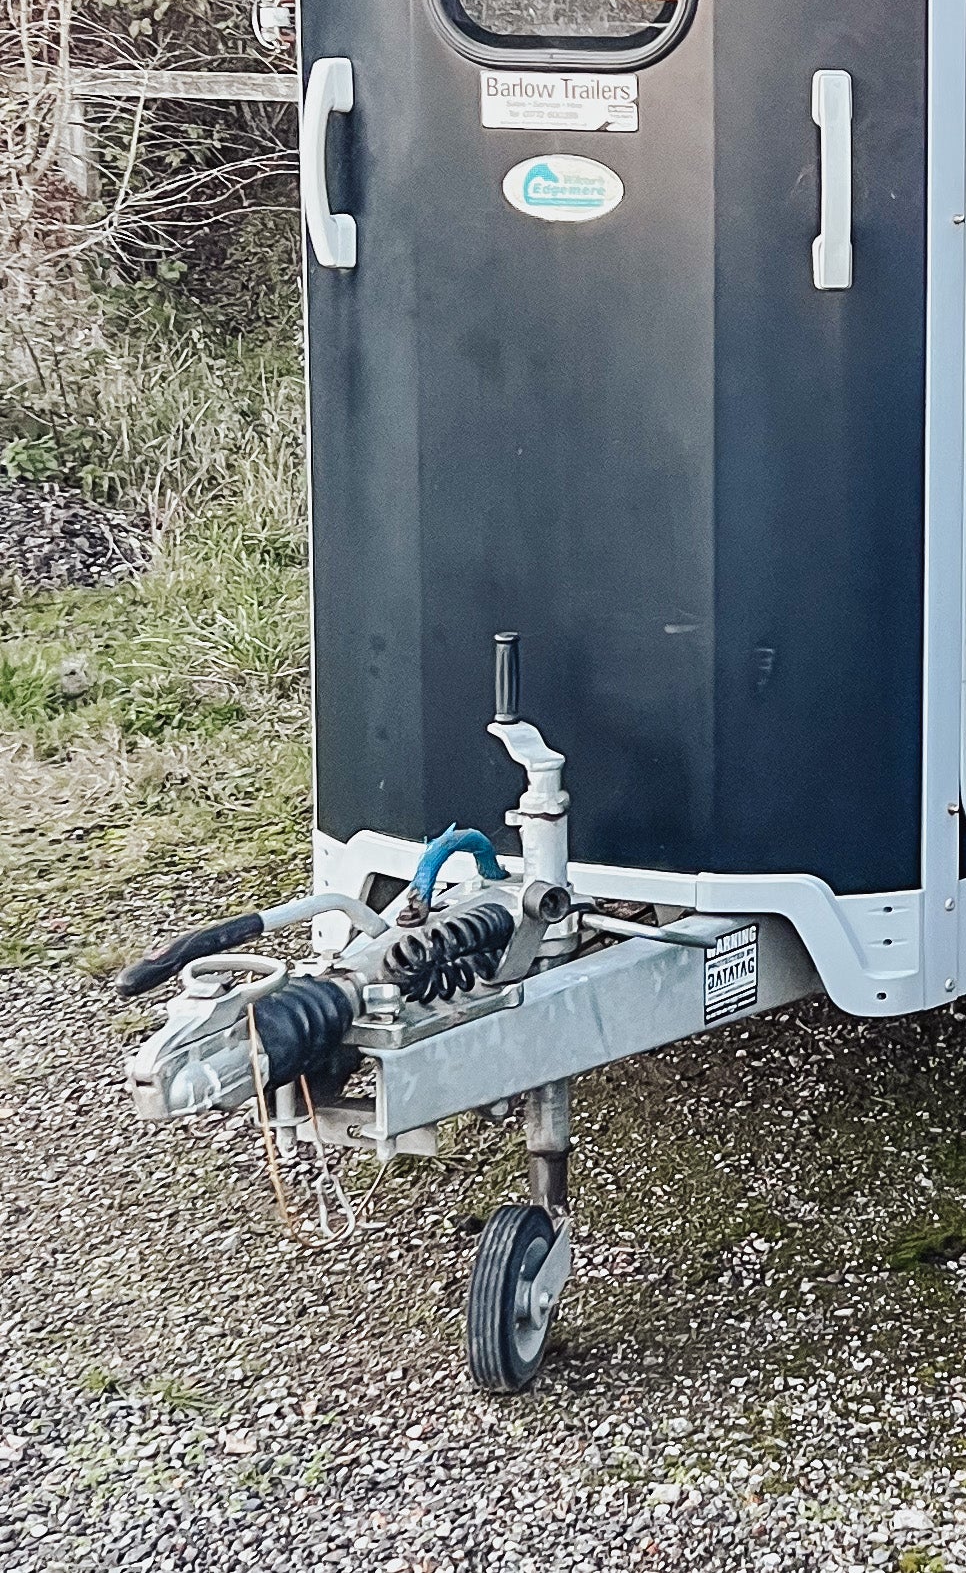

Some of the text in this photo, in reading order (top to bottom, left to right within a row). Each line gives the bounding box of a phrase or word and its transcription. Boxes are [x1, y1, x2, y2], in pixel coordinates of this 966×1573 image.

[486, 77, 631, 100] Barlow Trailers
[532, 183, 607, 196] Edgemere
[707, 957, 755, 990] DATATAG
